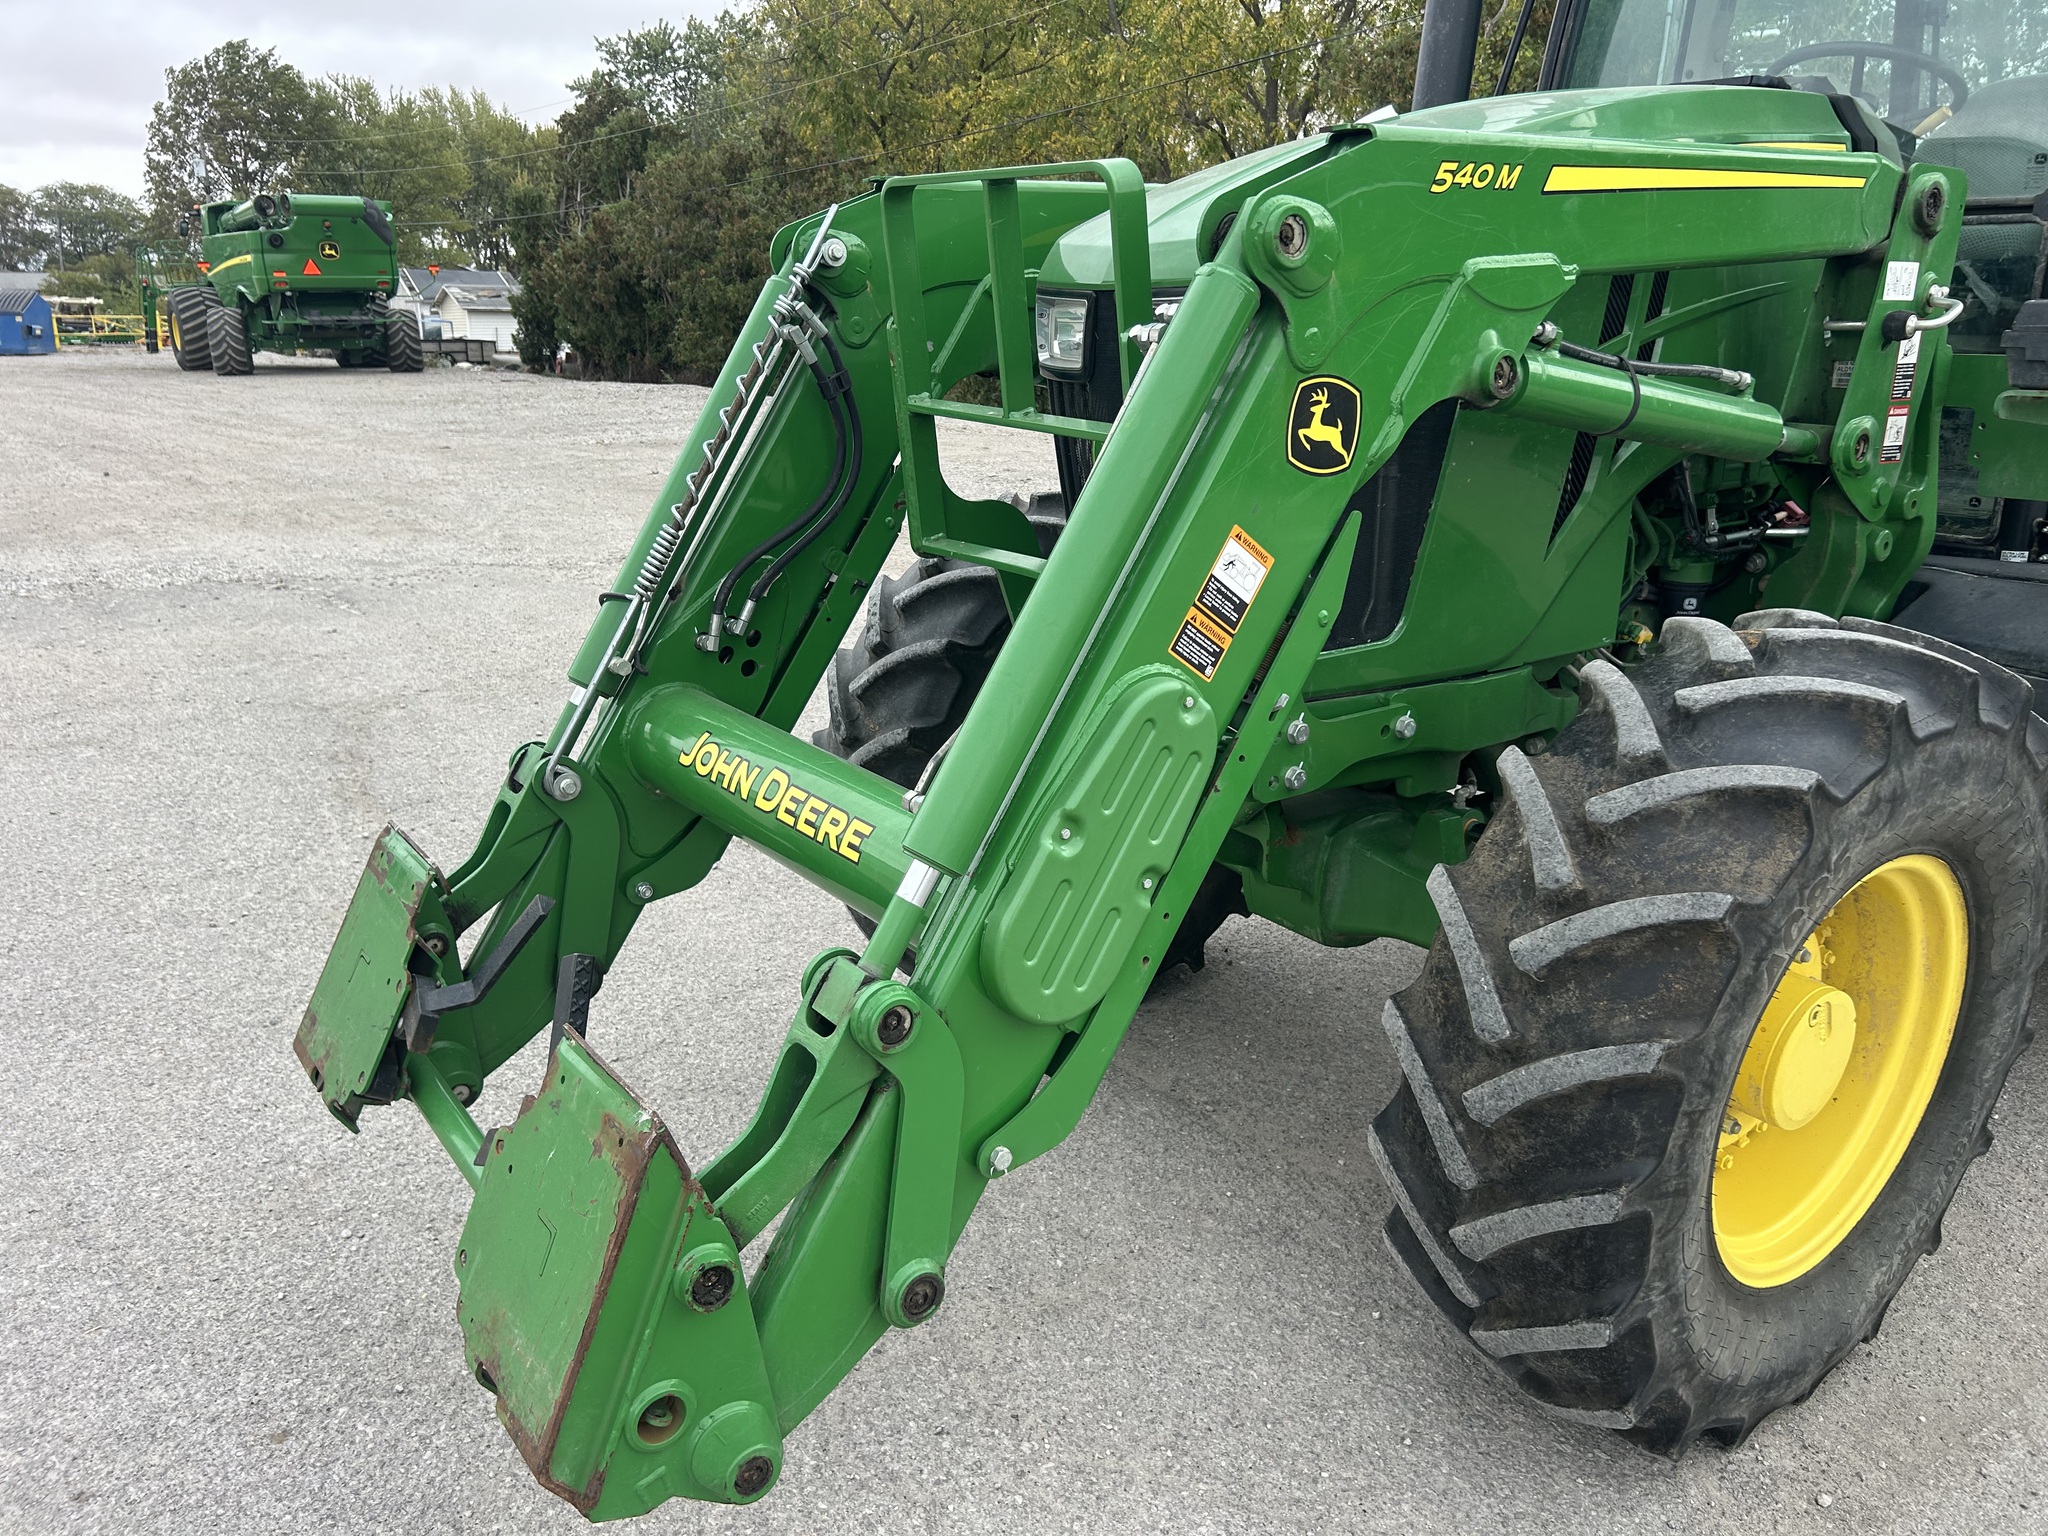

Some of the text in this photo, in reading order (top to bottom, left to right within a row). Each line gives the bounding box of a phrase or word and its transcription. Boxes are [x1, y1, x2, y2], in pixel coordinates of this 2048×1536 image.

[1242, 536, 1269, 563] WARNING
[1198, 619, 1226, 645] WARNING
[678, 731, 876, 865] JOHN DEERE
